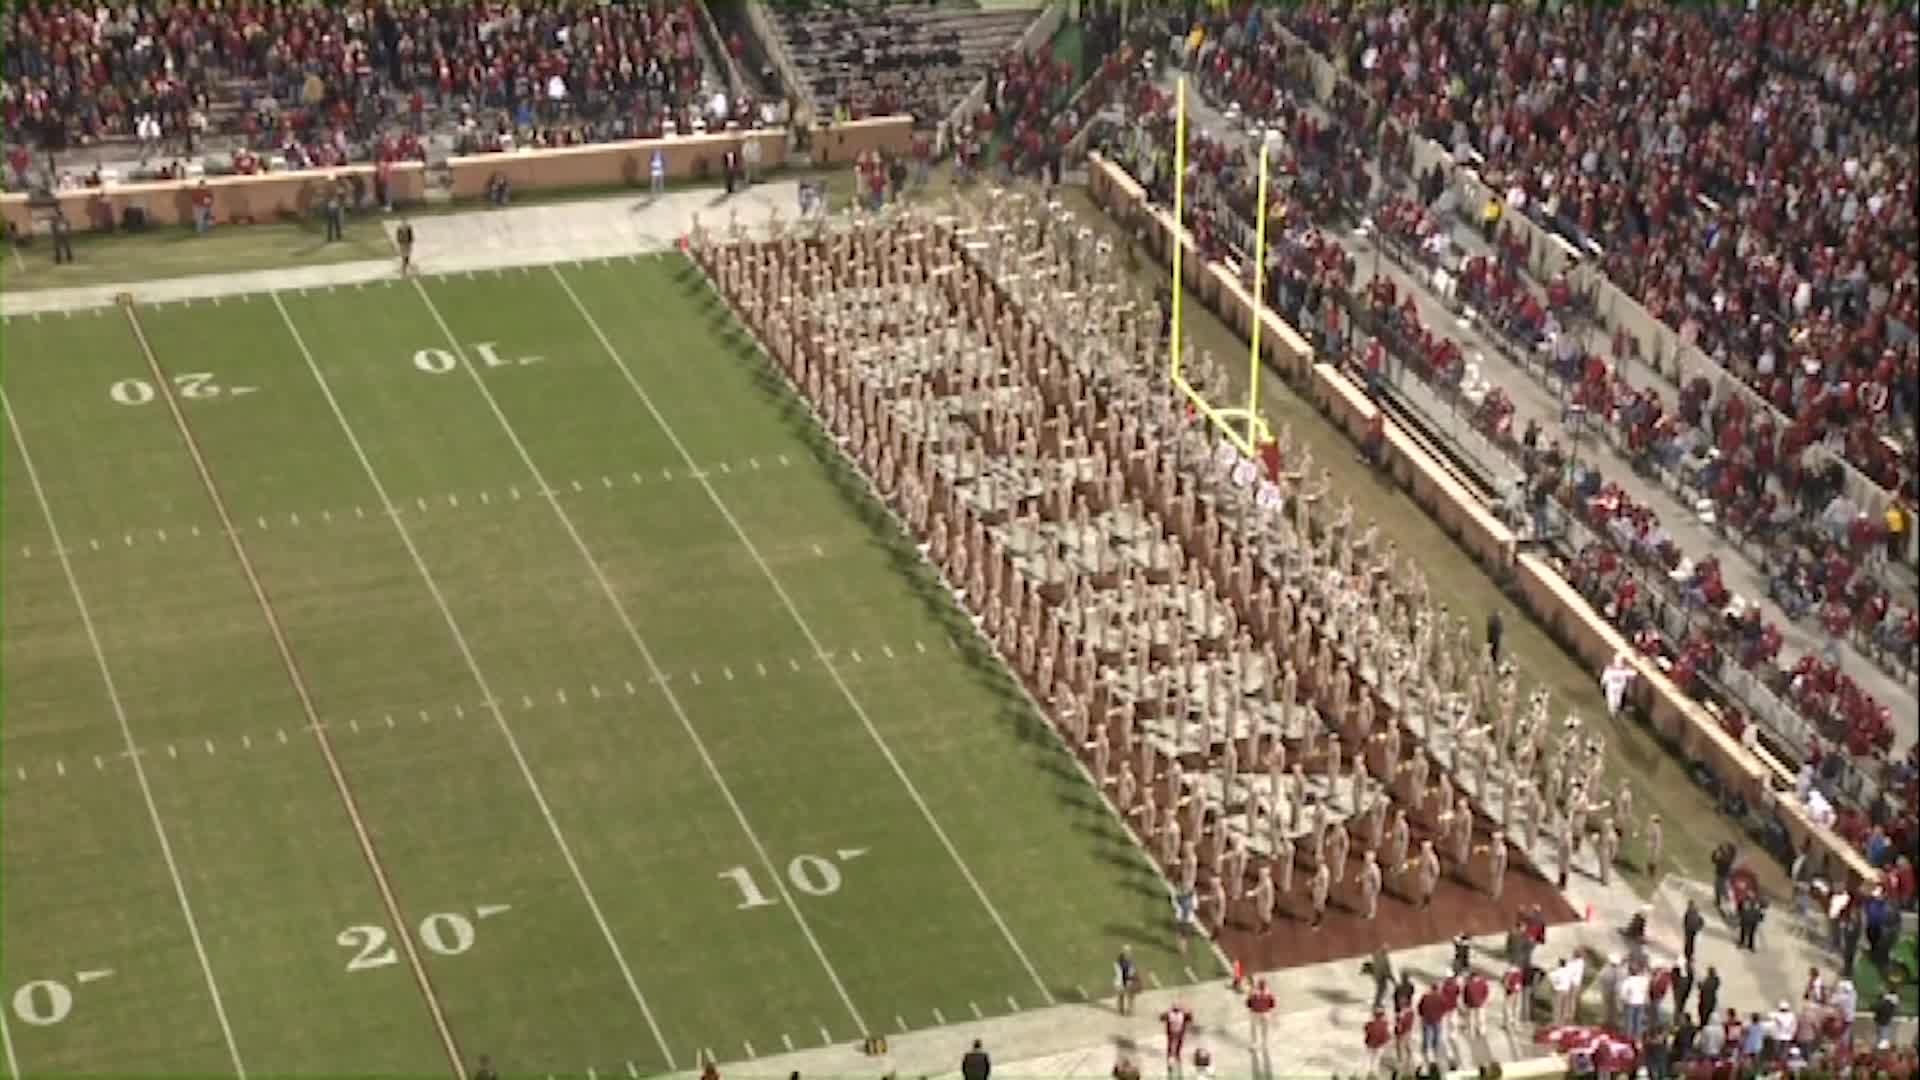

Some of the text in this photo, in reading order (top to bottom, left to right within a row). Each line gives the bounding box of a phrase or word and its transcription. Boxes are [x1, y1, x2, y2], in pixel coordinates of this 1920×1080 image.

[413, 342, 512, 374] 10
[110, 373, 219, 405] 20
[717, 854, 841, 909] 10
[336, 913, 475, 972] 20
